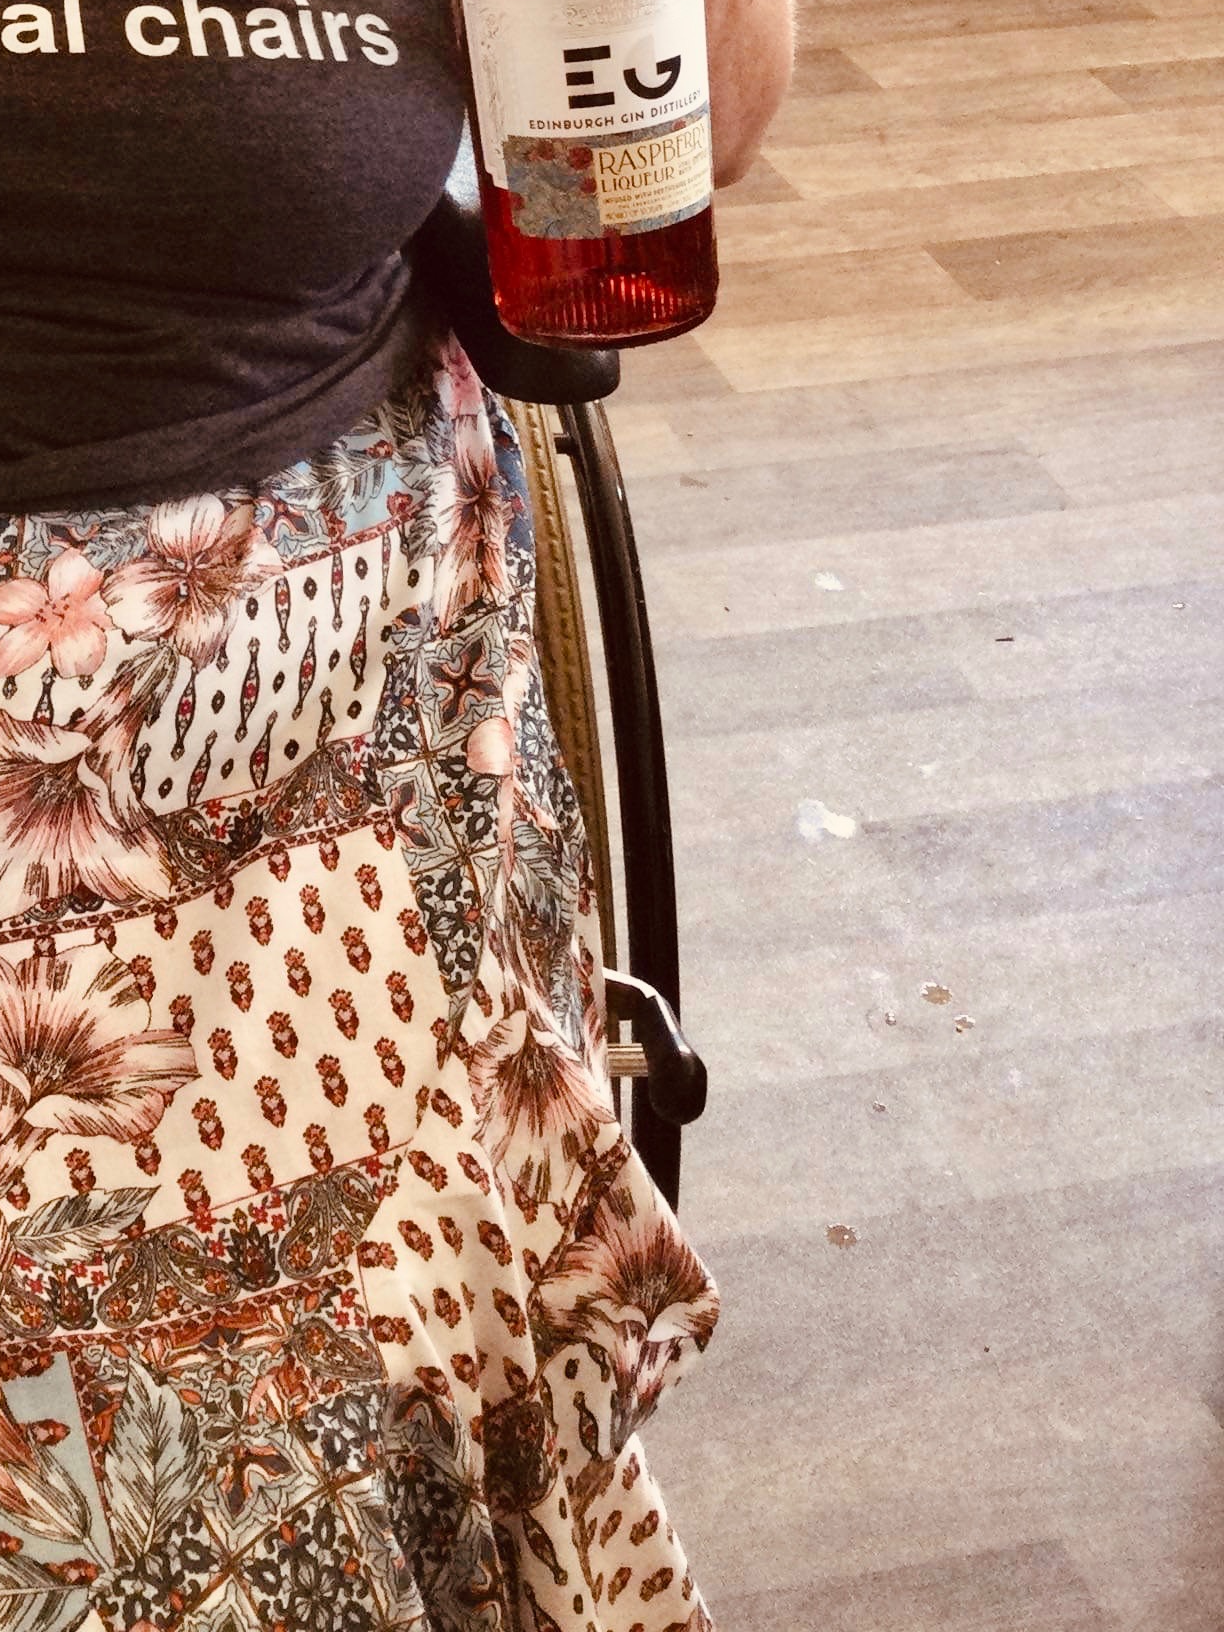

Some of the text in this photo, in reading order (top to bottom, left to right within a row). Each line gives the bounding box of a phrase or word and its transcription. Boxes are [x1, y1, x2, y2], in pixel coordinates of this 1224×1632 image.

[563, 34, 682, 110] EG
[528, 116, 615, 131] EDINBURGH
[621, 110, 645, 124] GIN
[601, 166, 675, 193] LIQUEUR
